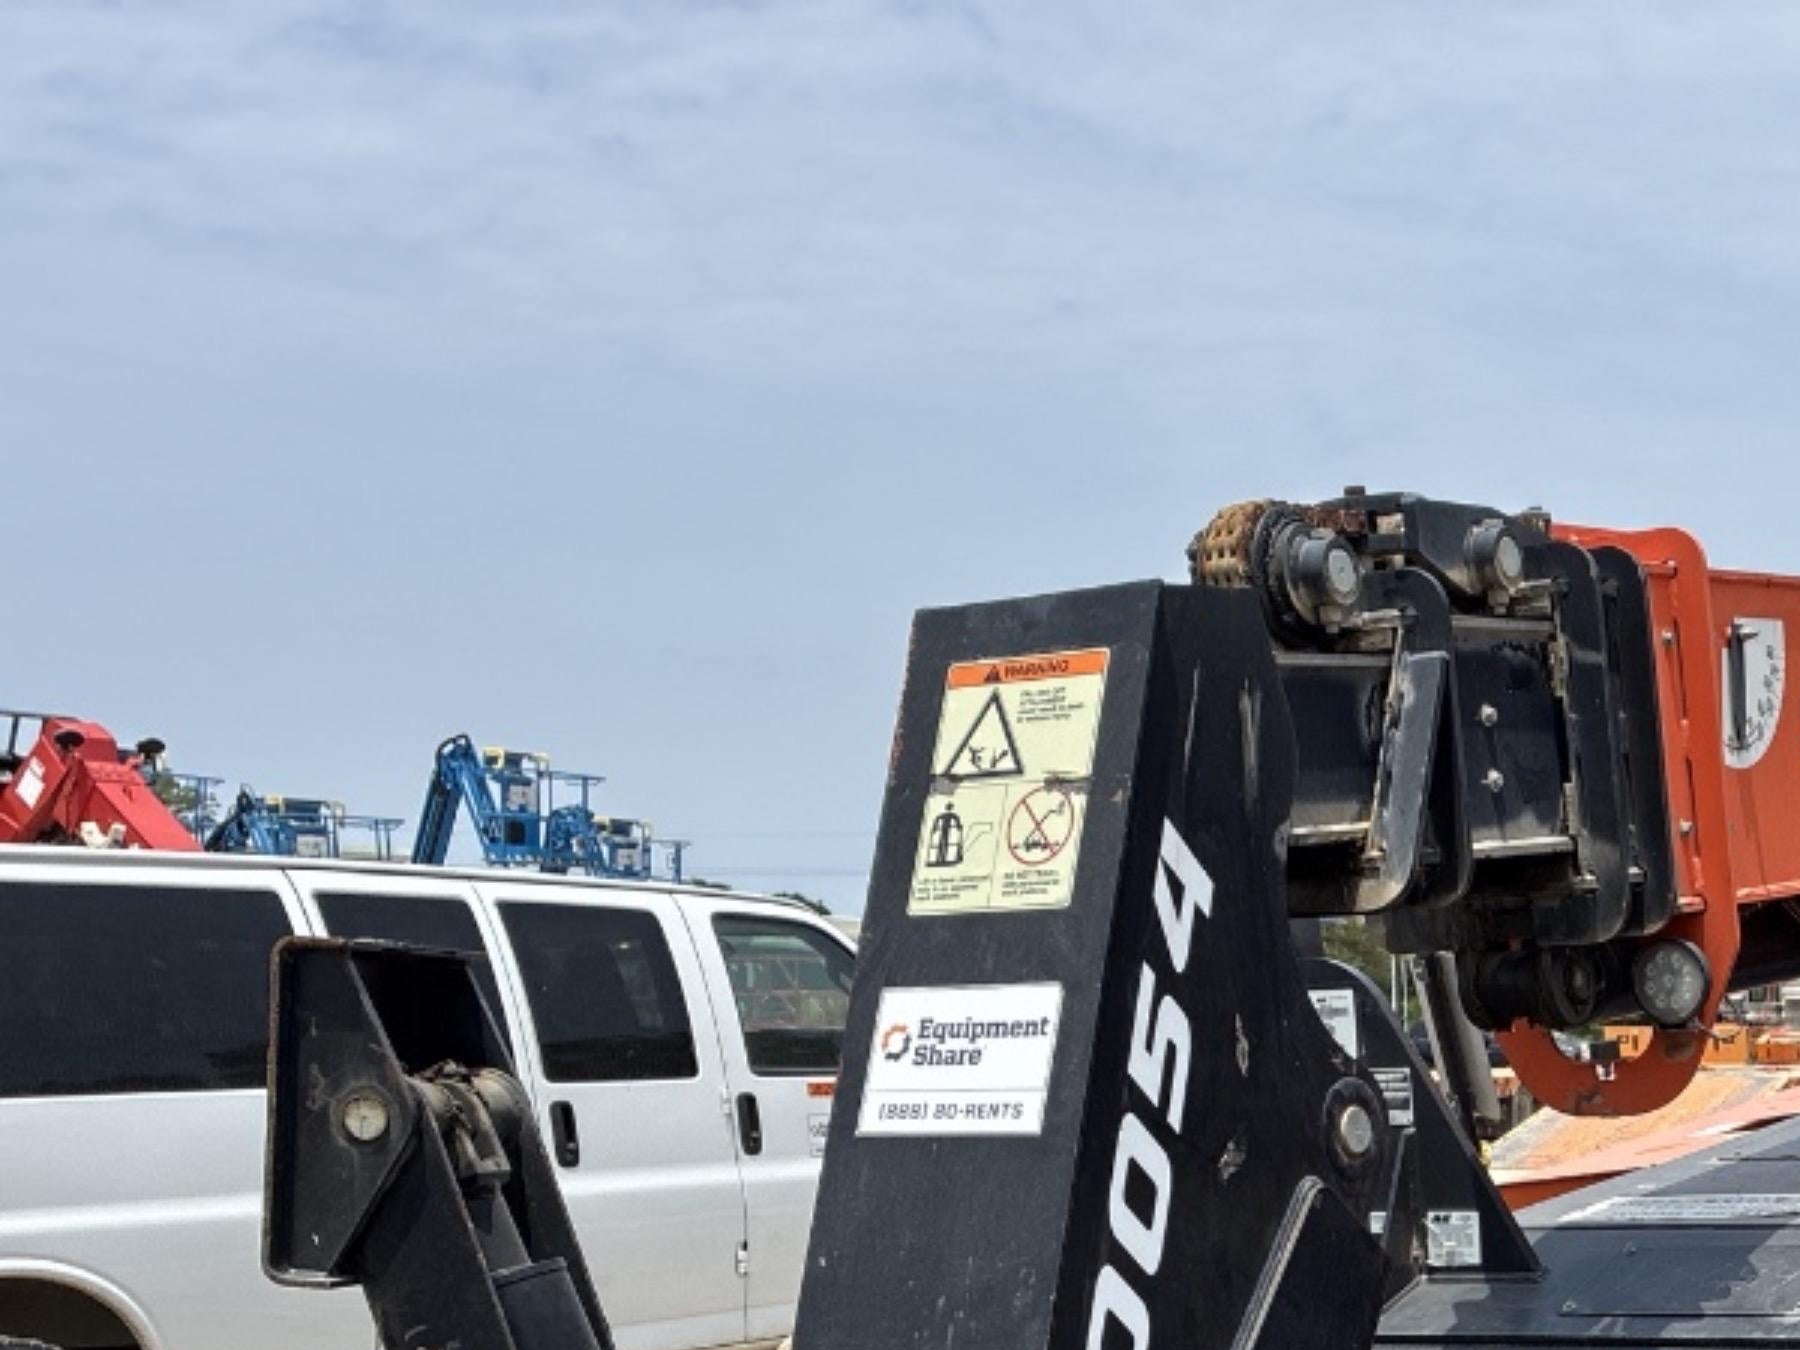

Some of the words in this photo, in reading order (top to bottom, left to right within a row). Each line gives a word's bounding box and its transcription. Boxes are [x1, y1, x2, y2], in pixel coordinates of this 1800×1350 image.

[917, 1016, 1051, 1044] Equipment
[912, 1043, 983, 1066] Share
[878, 1102, 929, 1121] (888)
[932, 1102, 1025, 1120] 80-RENTS
